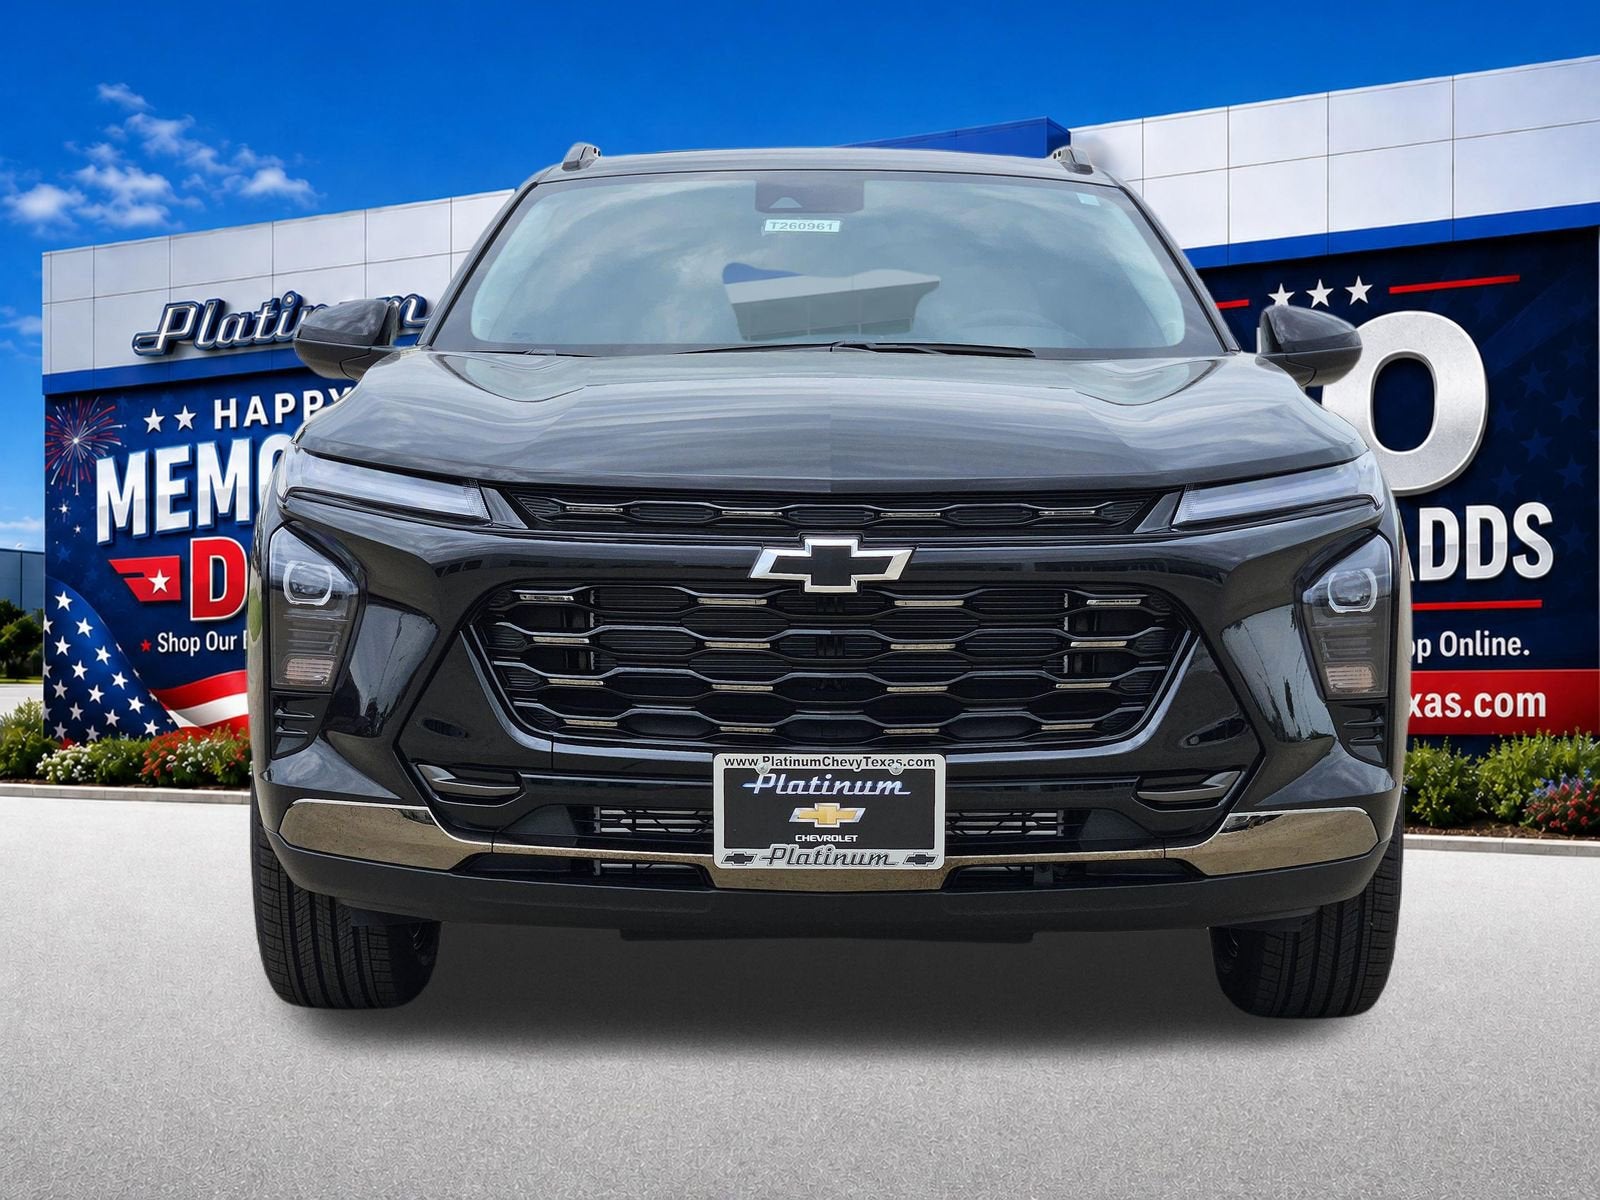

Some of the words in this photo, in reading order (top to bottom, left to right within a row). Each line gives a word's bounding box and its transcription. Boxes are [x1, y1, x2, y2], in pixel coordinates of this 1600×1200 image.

[771, 222, 834, 231] T260961
[1398, 501, 1554, 582] DDS
[157, 632, 200, 657] Shop
[205, 630, 238, 651] Our
[1439, 630, 1530, 657] Online.
[724, 756, 935, 770] wwwPlatinumChevyTexas.com
[742, 773, 912, 795] Platinum
[795, 834, 858, 842] CHEVROLET
[760, 846, 899, 866] Platinum
